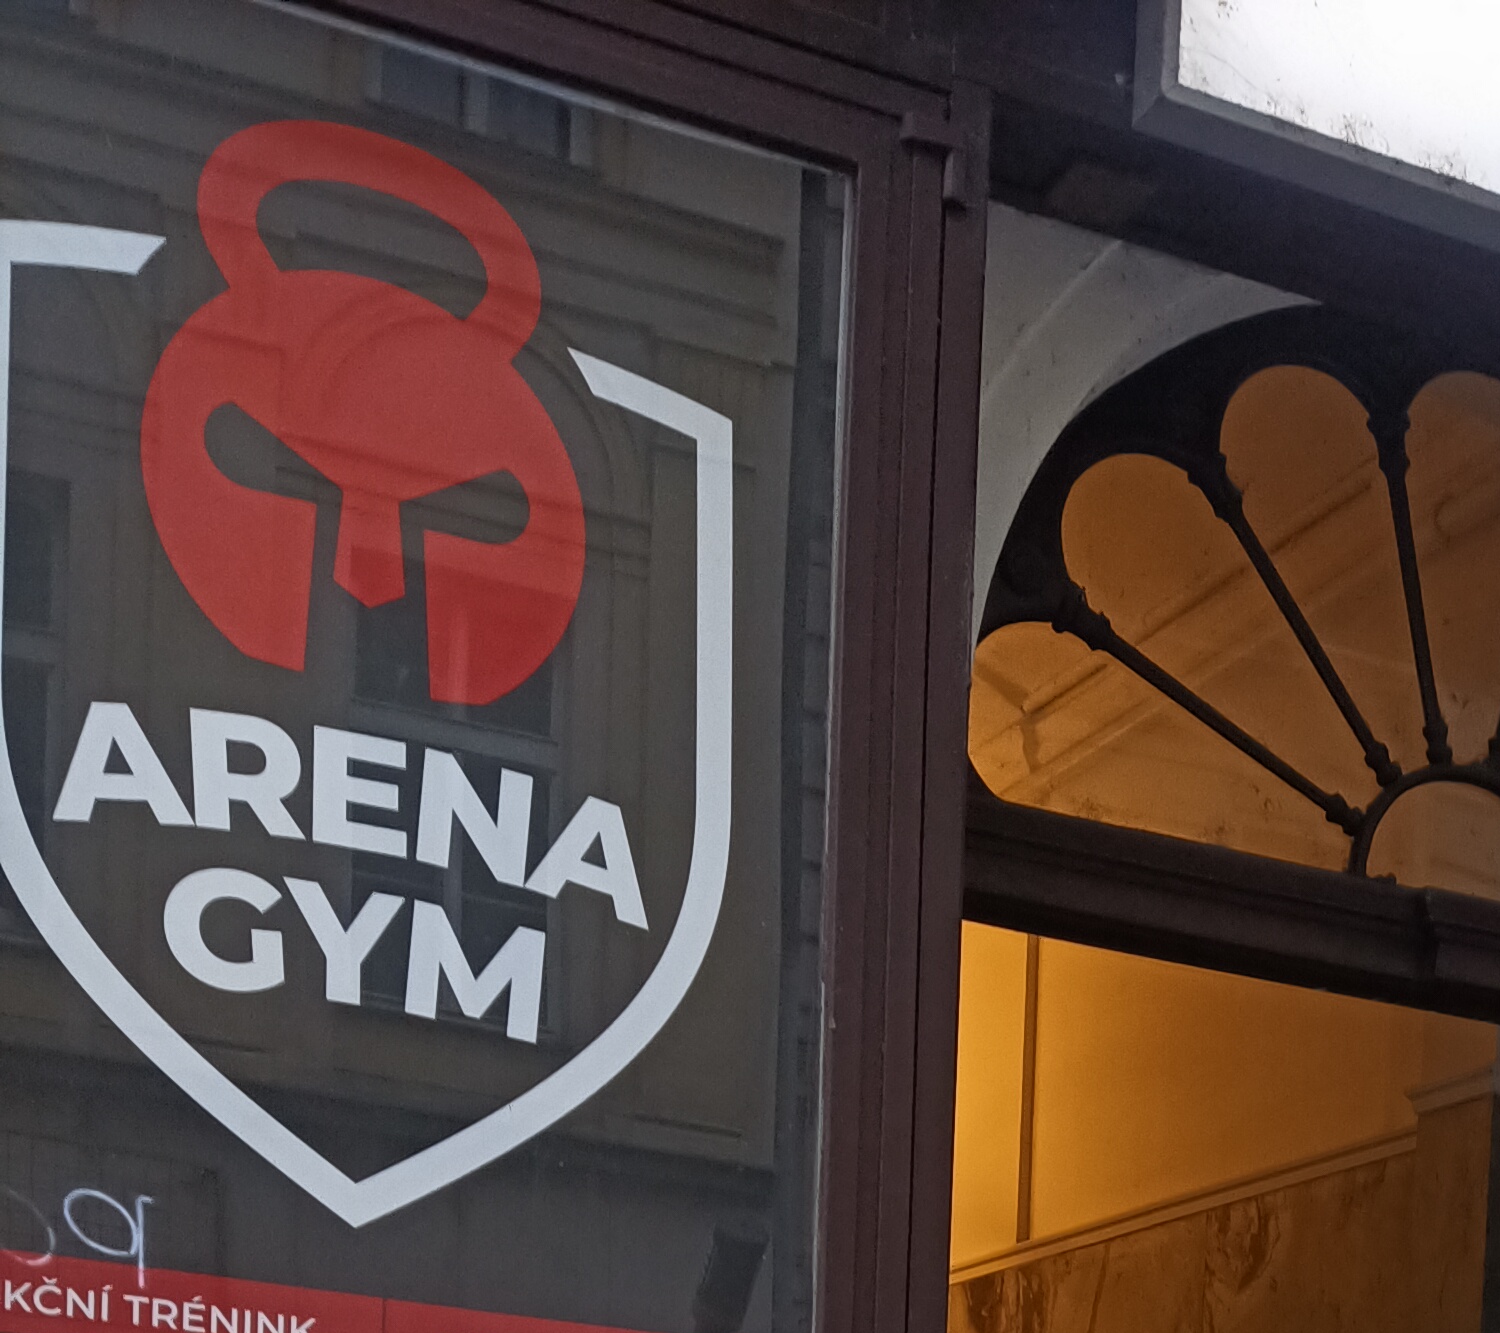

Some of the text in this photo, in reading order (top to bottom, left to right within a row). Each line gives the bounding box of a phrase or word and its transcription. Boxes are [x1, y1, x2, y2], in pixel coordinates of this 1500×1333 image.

[52, 701, 649, 931] ARENA
[163, 867, 545, 1044] GYM
[4, 1276, 113, 1323] KČNÍ
